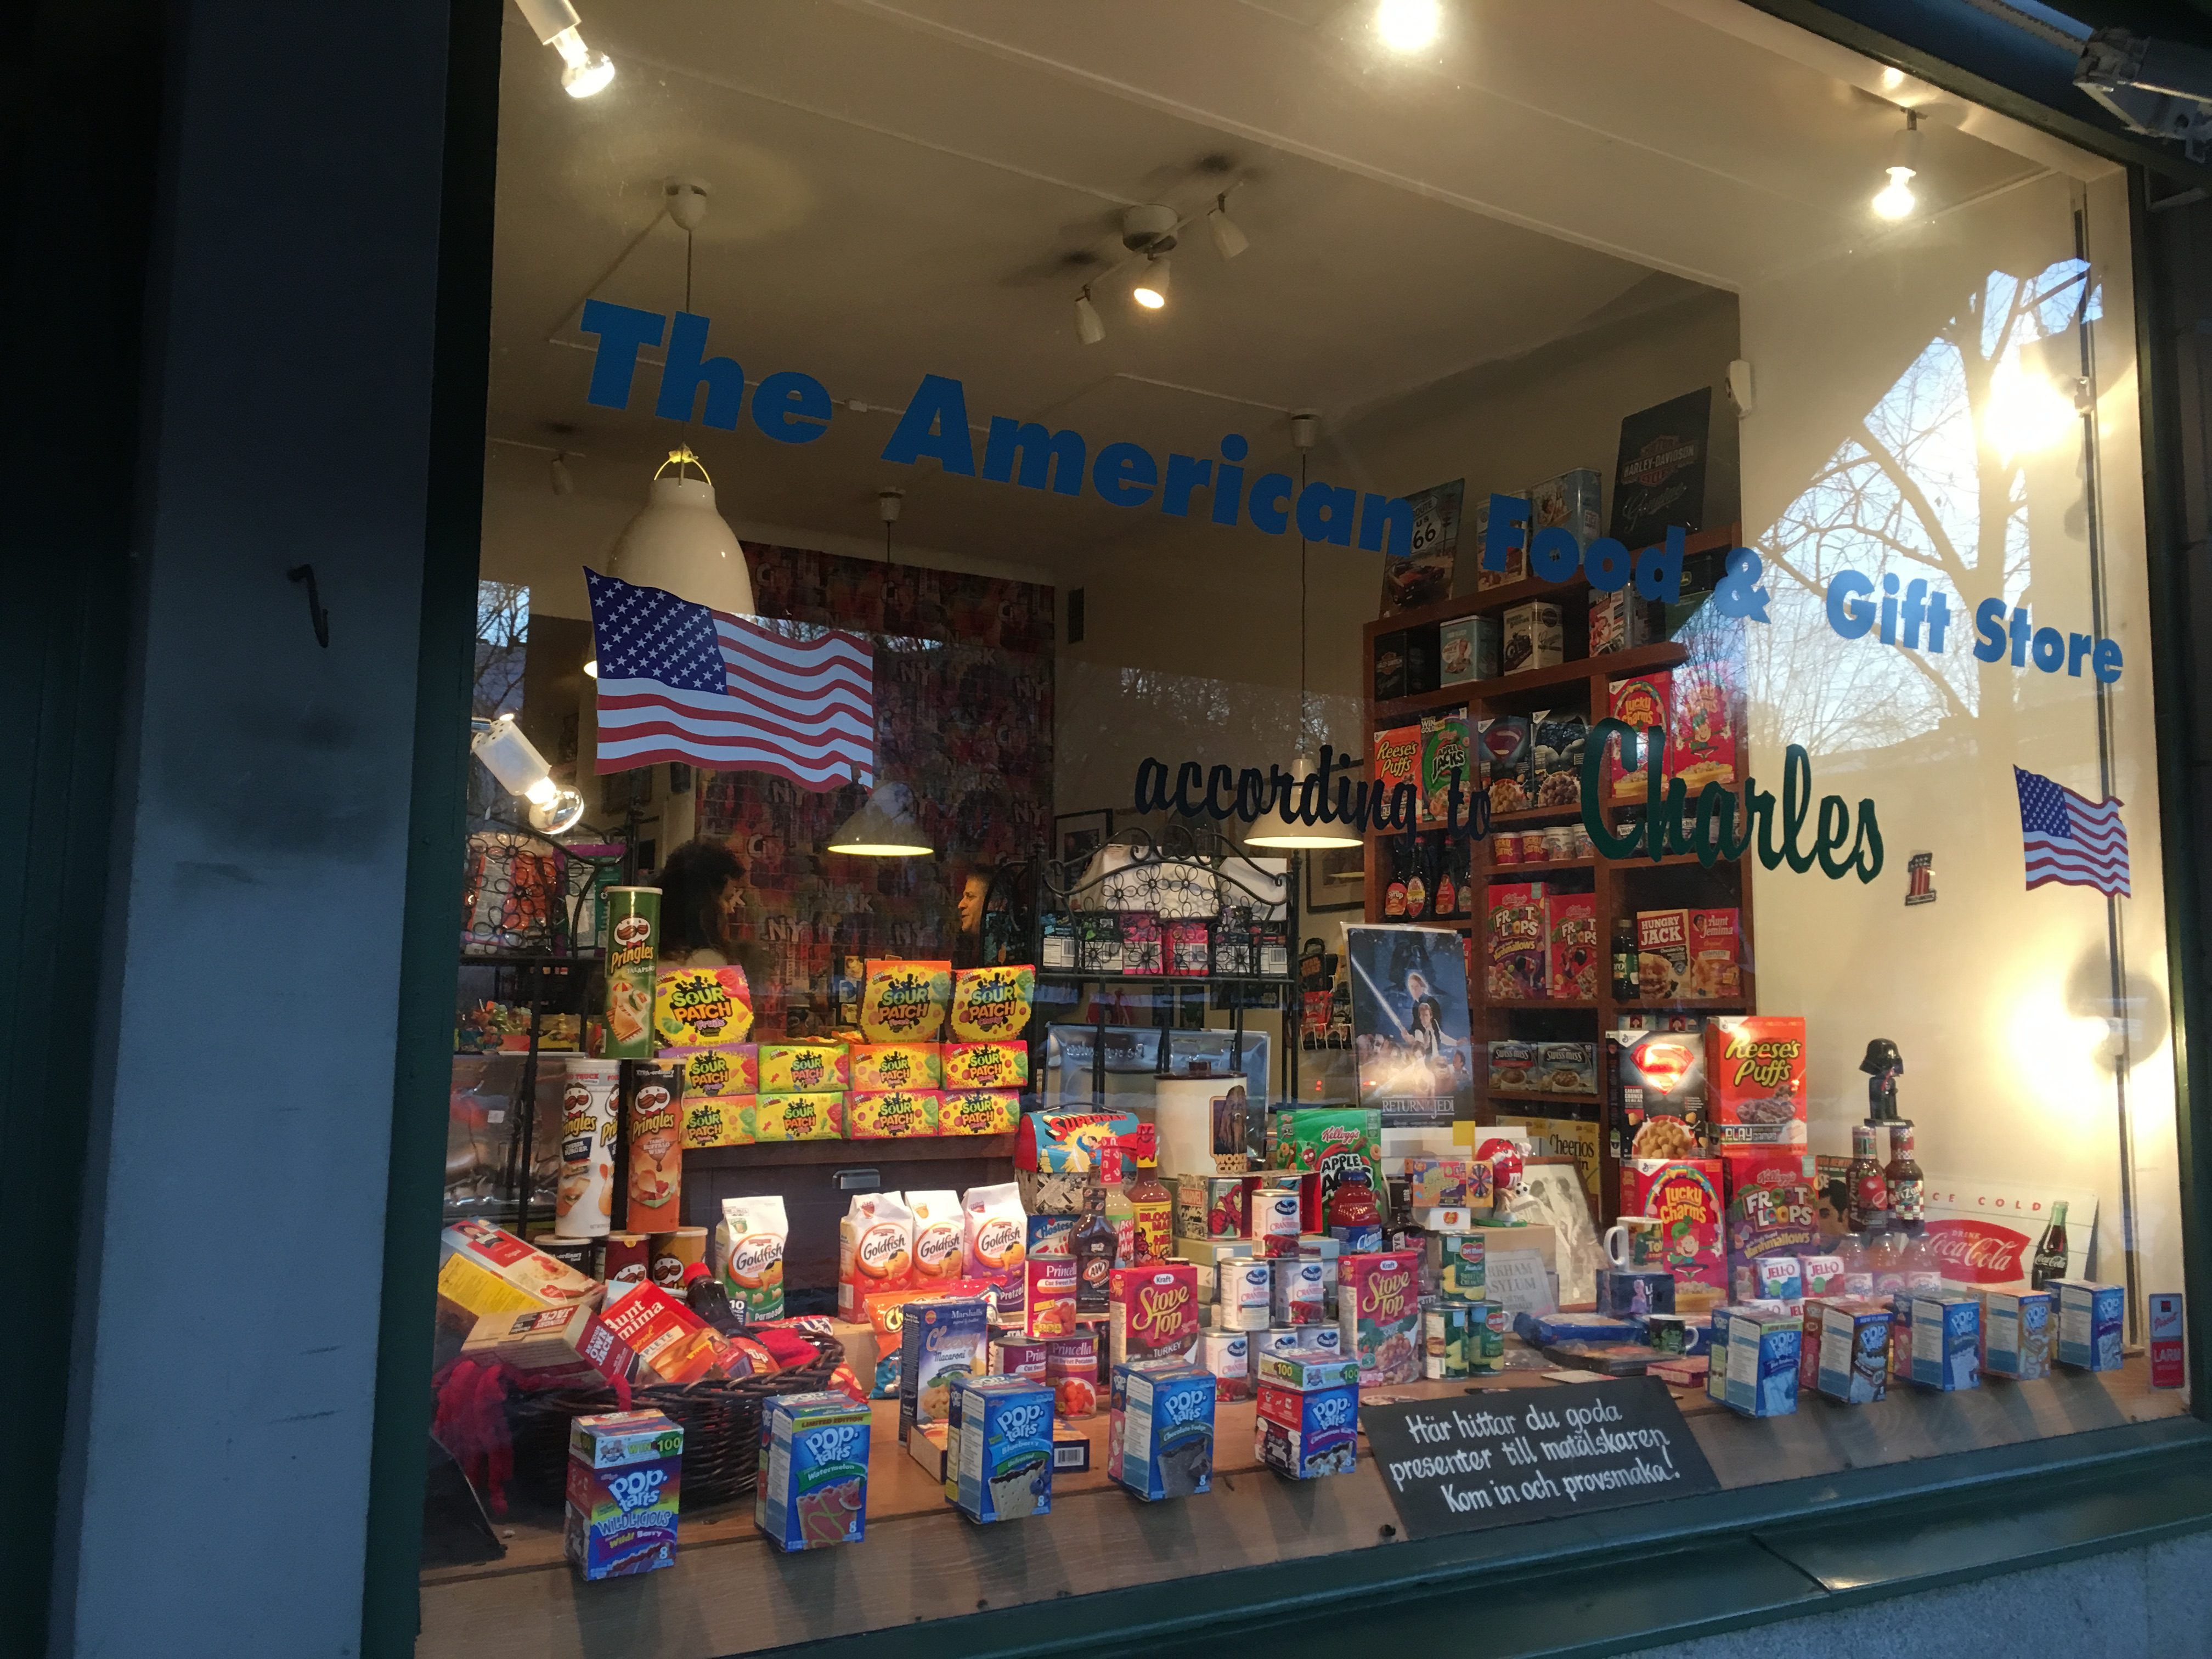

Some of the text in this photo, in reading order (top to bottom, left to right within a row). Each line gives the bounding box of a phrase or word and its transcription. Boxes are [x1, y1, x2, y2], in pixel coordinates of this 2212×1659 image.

[580, 298, 2124, 684] The American Food & Gift Store
[1413, 523, 1436, 549] 66
[1376, 741, 1418, 760] Reese's
[1438, 744, 1458, 756] APPLE
[1381, 759, 1412, 778] Puffs
[1431, 749, 1465, 783] JACKS
[1135, 716, 1884, 885] according to Charles
[1641, 915, 1680, 930] HUNGRY
[1708, 915, 1729, 926] Aunt
[1640, 926, 1683, 946] JACK
[1700, 926, 1734, 939] Jemima
[610, 942, 654, 974] Pringles
[669, 987, 726, 1006] SOUR
[881, 988, 928, 1006] SOUR
[970, 986, 1015, 1005] SOUR
[673, 1001, 732, 1023] PATCH
[878, 1003, 929, 1022] PATCH
[968, 1001, 1017, 1020] PATCH
[1725, 1036, 1802, 1059] Reese's
[690, 1059, 727, 1075] SOUR
[791, 1057, 822, 1072] SOUR
[880, 1058, 910, 1072] SOUR
[968, 1053, 1002, 1068] SOUR
[689, 1071, 730, 1087] PATCH
[791, 1068, 824, 1081] PATCH
[879, 1069, 911, 1081] PATCH
[968, 1063, 1003, 1078] PATCH
[1734, 1059, 1793, 1087] Puffs
[783, 1105, 816, 1120] SOUR
[879, 1101, 912, 1115] SOUR
[960, 1099, 994, 1114] SOUR
[1382, 1099, 1425, 1112] RETURN
[1431, 1099, 1455, 1119] JEDI
[633, 1112, 675, 1139] Pringles
[687, 1112, 720, 1127] SOUR
[783, 1116, 817, 1130] PATCH
[878, 1112, 915, 1126] PATCH
[960, 1110, 996, 1125] PATCH
[687, 1124, 723, 1138] PATCH
[1049, 1114, 1128, 1142] SUPERMAN
[1322, 1125, 1361, 1145] Kellogg's
[1725, 1128, 1753, 1141] PLAY
[1321, 1153, 1362, 1173] APPLE
[1746, 1187, 1807, 1214] FROOT
[1933, 1192, 2041, 1211] CE COLD
[1757, 1205, 1813, 1227] LOOPS
[1040, 1221, 1074, 1238] Hostess
[1953, 1229, 1981, 1240] DRINK
[863, 1234, 907, 1261] Goldfish
[919, 1234, 961, 1259] Goldfish
[981, 1228, 1022, 1252] Goldfish
[736, 1242, 784, 1271] Goldfish
[1487, 1263, 1533, 1277] RKHAM
[1767, 1263, 1795, 1279] JELL-O
[1810, 1261, 1839, 1277] JELL-O
[1362, 1272, 1411, 1313] Stove
[729, 1300, 745, 1310] 10
[951, 1308, 983, 1319] Marshalls
[1132, 1286, 1189, 1330] Stove
[1379, 1294, 1404, 1321] Top
[604, 1300, 646, 1332] Aunt
[618, 1302, 665, 1341] mima
[1152, 1311, 1182, 1340] Top
[590, 1327, 607, 1359] OWN
[596, 1333, 614, 1367] JACK
[1051, 1341, 1092, 1356] Princella
[1153, 1340, 1182, 1358] TURKEY
[934, 1350, 966, 1362] Macaroni
[1277, 1363, 1293, 1377] 100
[1344, 1369, 1358, 1380] 100
[802, 1416, 864, 1428] LIMITED EDITION
[1172, 1407, 1202, 1425] tarts
[1406, 1398, 1623, 1444] Här hittar du goda
[1006, 1423, 1038, 1443] tarts
[657, 1437, 681, 1452] 100
[1001, 1440, 1040, 1455] Blueberry
[815, 1445, 851, 1466] tarts
[1389, 1425, 1671, 1493] presenter till matälskaren
[807, 1464, 855, 1481] Watermelon
[1199, 1474, 1206, 1486] 8
[1440, 1446, 1680, 1514] Kom in och provsmaka!
[619, 1490, 661, 1512] tarts
[1037, 1495, 1045, 1507] 8
[636, 1530, 663, 1539] Berry
[849, 1520, 857, 1533] 8
[659, 1547, 668, 1559] 8
